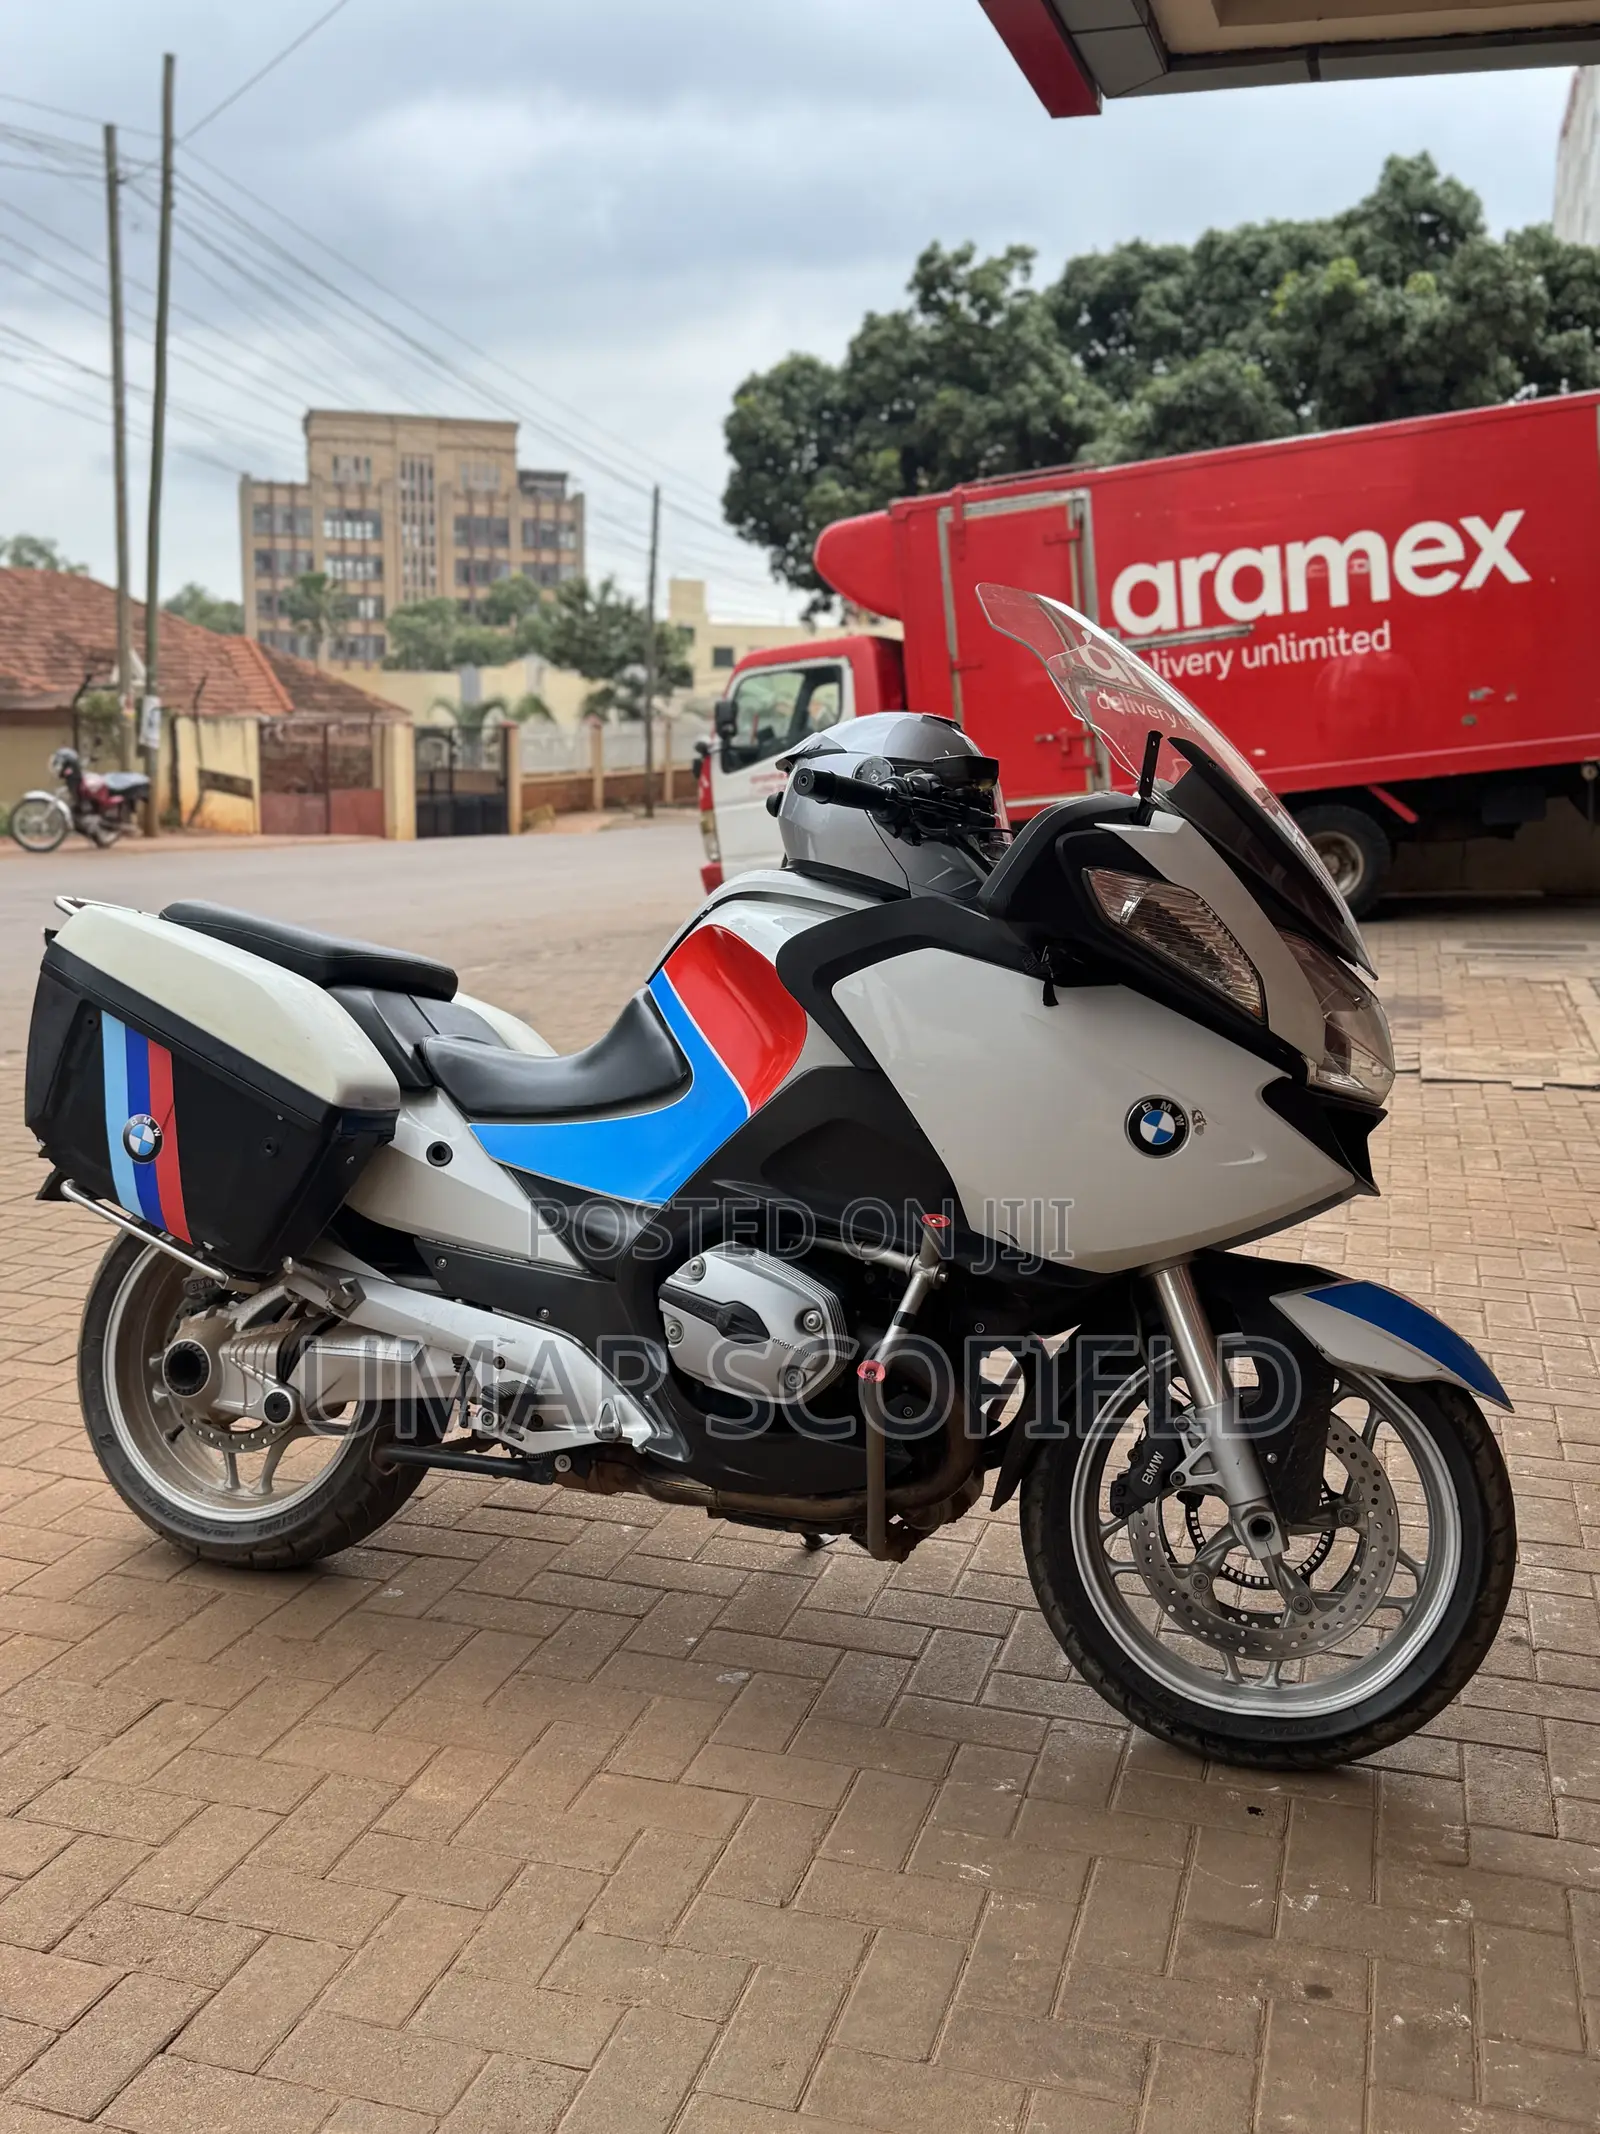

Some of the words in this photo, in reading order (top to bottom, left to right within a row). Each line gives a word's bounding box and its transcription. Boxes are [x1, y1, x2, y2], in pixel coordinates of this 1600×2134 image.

[1111, 509, 1532, 635] aramex
[1149, 648, 1235, 681] livery
[1241, 621, 1391, 669] unlimited
[131, 1116, 162, 1137] BMW
[1141, 1101, 1185, 1127] BMW
[1141, 1450, 1165, 1486] BMW
